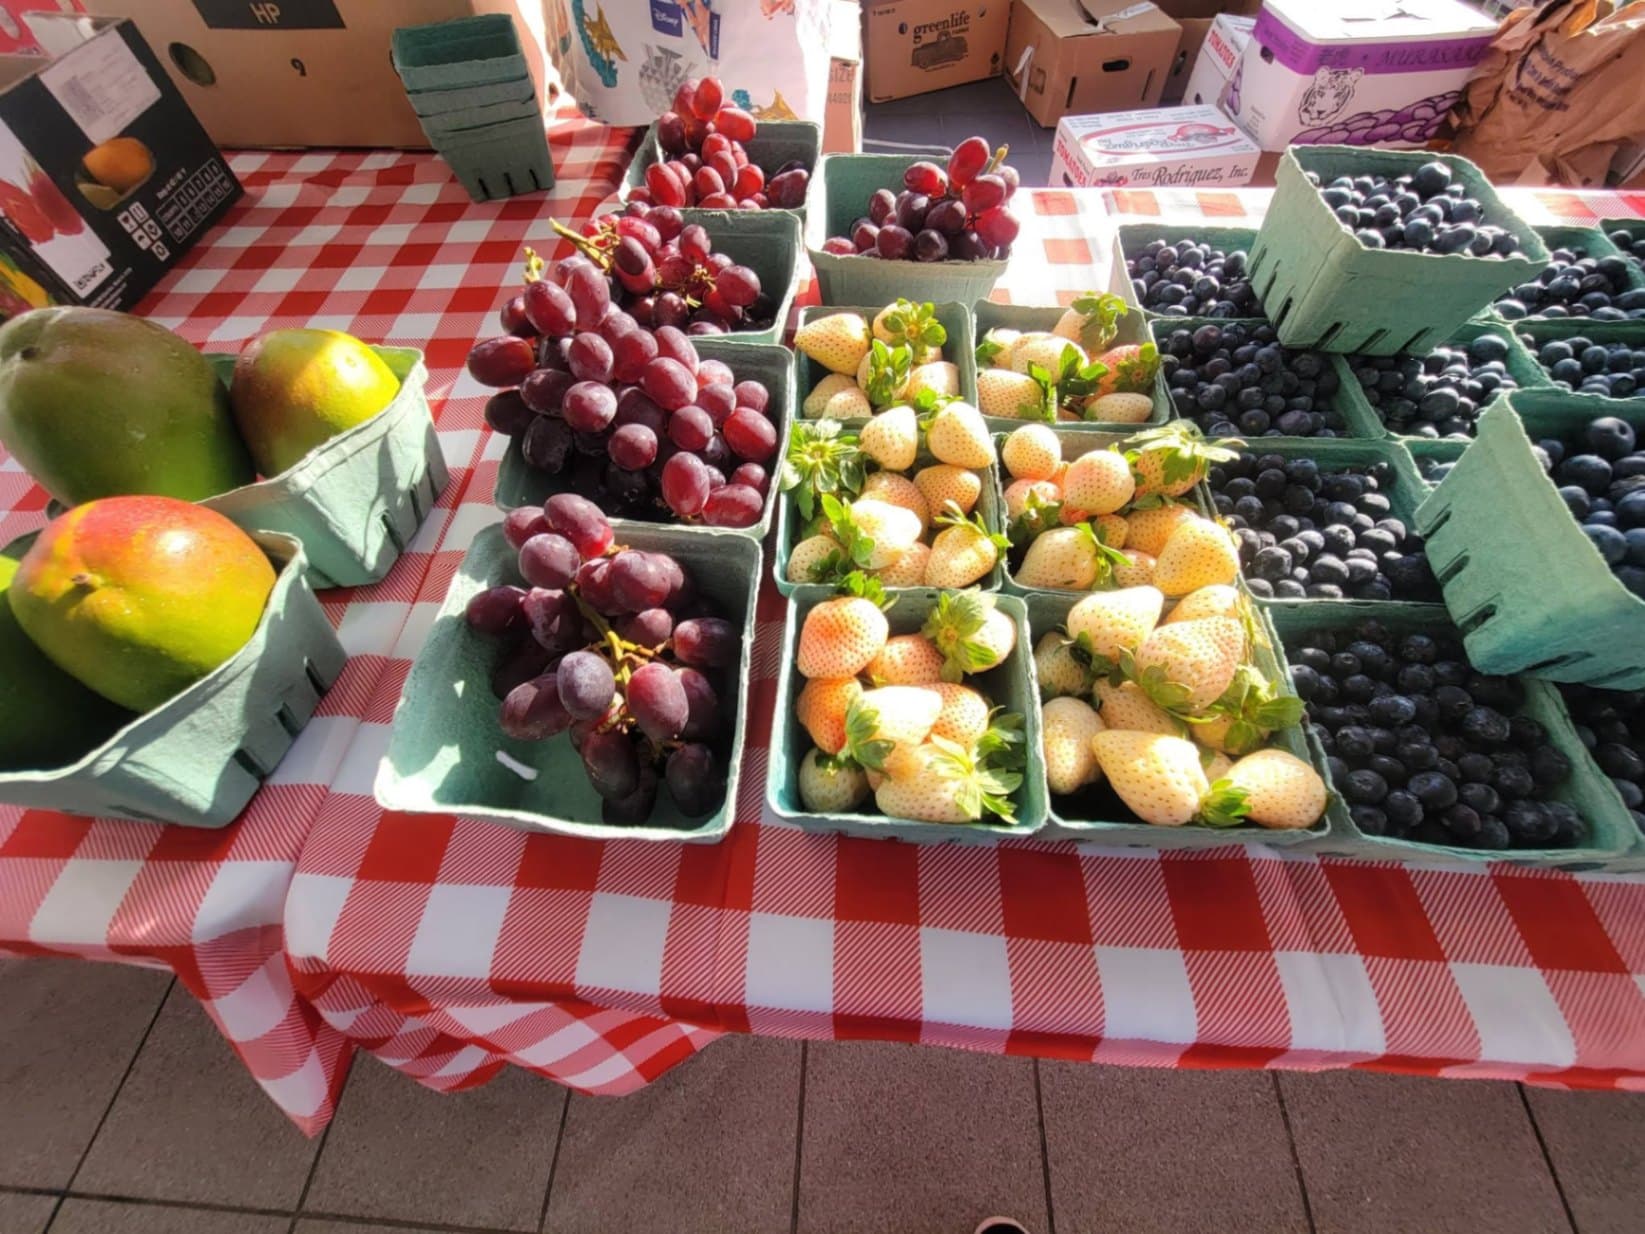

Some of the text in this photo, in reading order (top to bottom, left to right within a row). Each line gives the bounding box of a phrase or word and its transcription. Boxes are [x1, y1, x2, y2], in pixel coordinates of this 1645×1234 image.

[249, 2, 281, 24] HP
[913, 10, 970, 44] greenlife
[1131, 163, 1249, 186] Tres Rodriguez, Inc.
